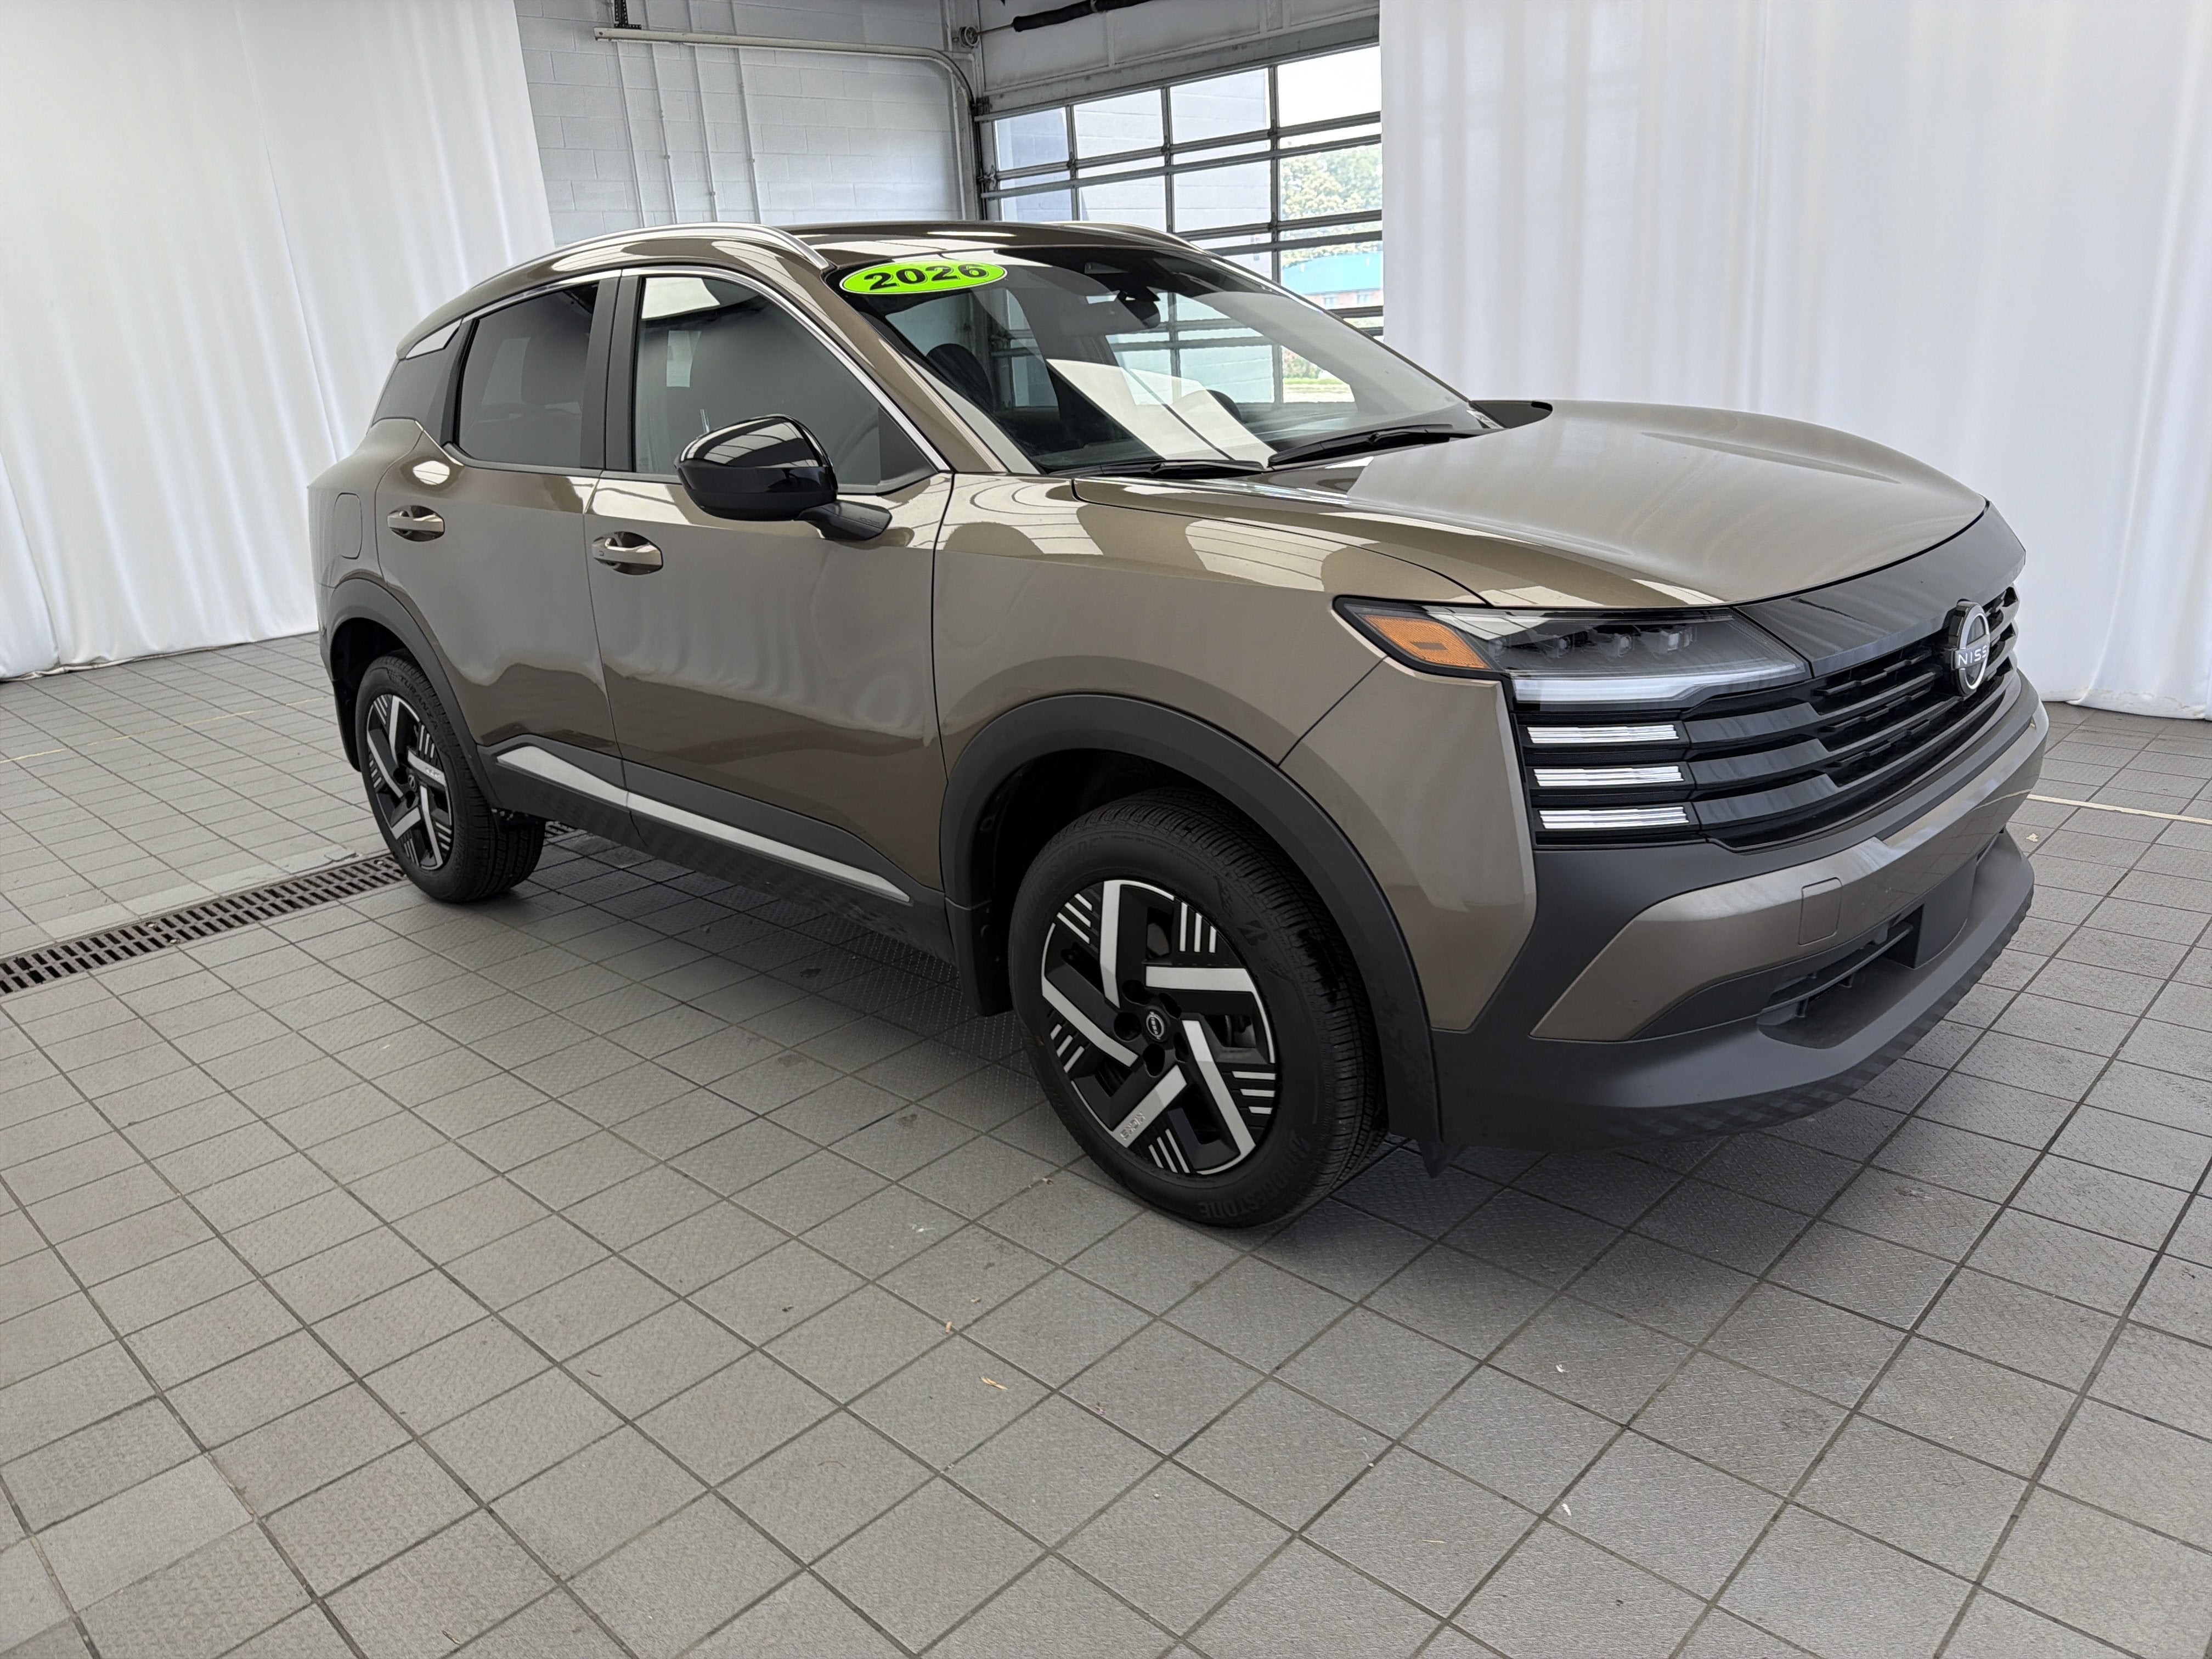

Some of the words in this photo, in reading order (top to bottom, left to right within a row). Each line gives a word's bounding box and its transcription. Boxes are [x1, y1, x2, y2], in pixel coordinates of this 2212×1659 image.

[864, 263, 989, 291] 2026
[1957, 645, 1988, 667] NISS
[400, 675, 438, 730] TURANZA
[1120, 1112, 1146, 1141] KICKS
